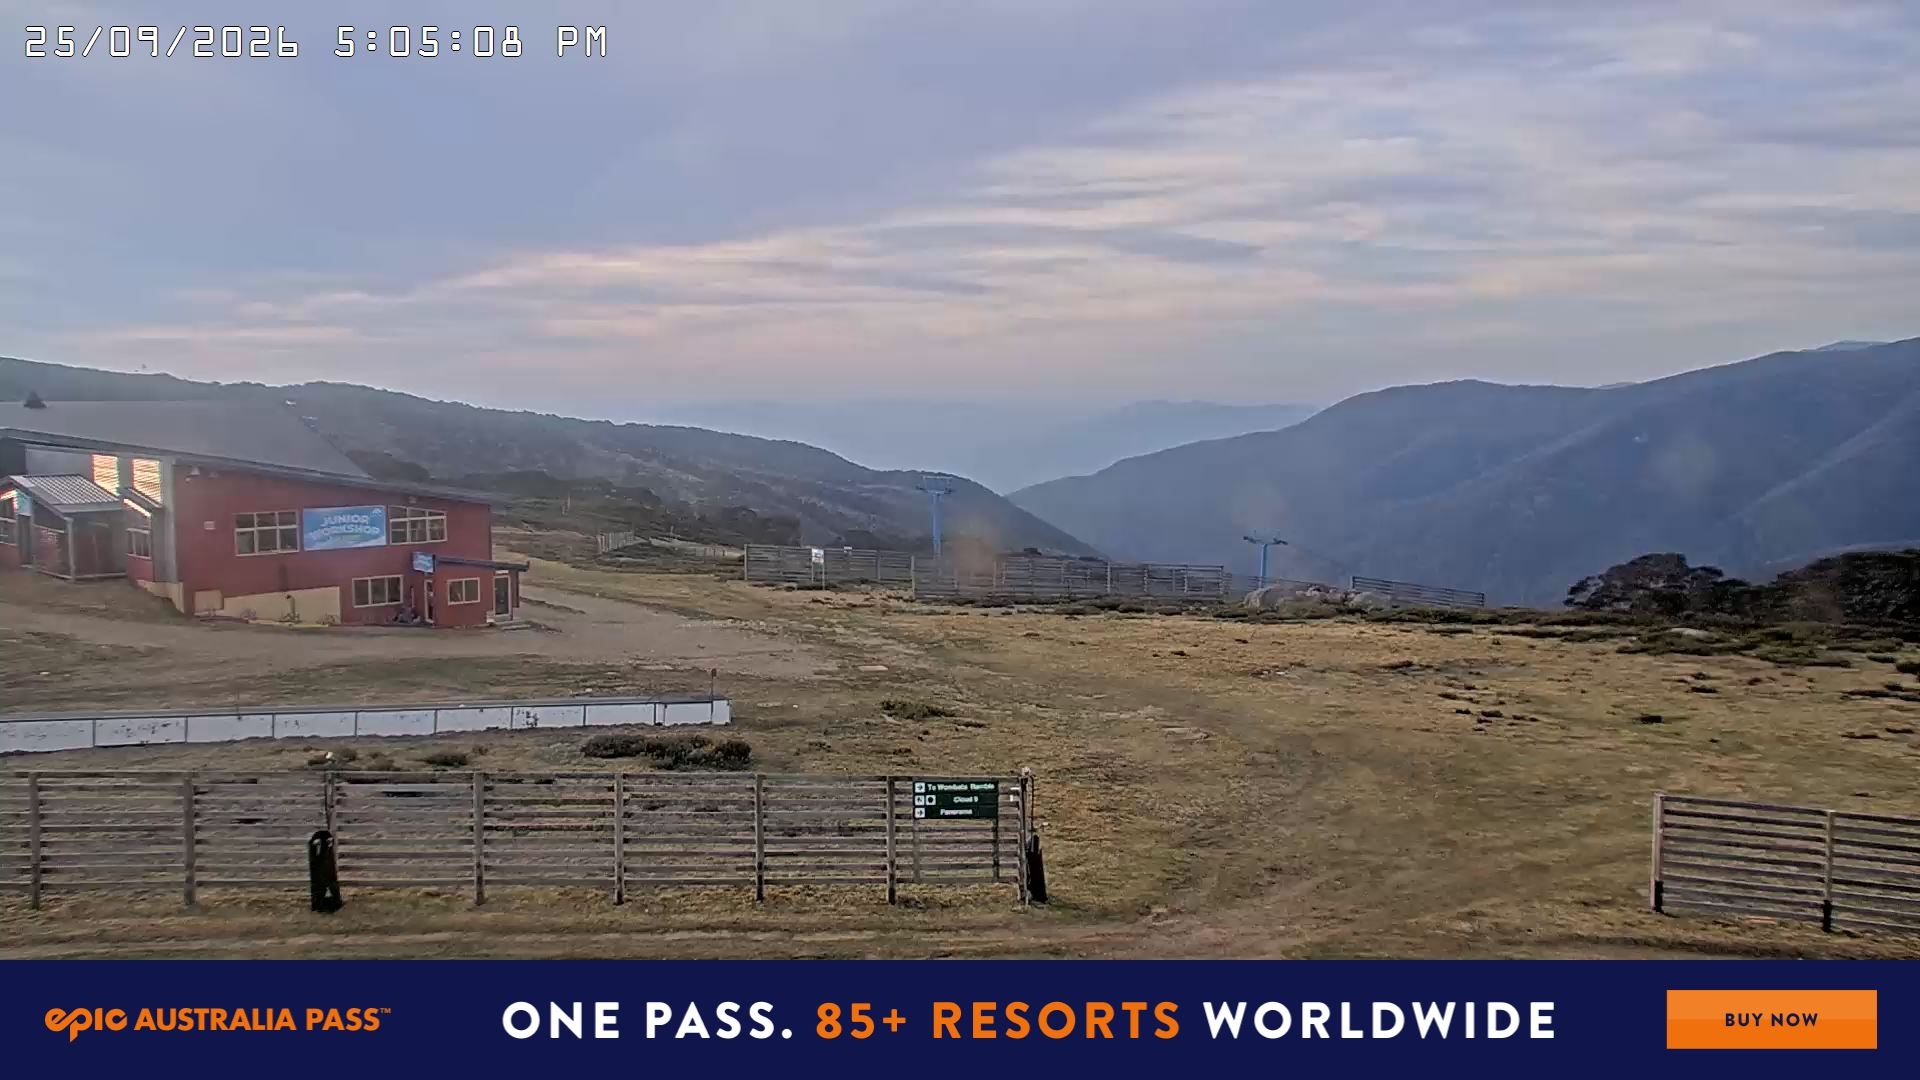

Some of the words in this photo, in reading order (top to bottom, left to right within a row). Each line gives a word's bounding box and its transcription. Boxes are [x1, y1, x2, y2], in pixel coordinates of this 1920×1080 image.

[320, 514, 369, 527] JUNIOR
[308, 524, 380, 541] WORKSHOP
[927, 783, 937, 791] To
[940, 808, 973, 816] Panorama
